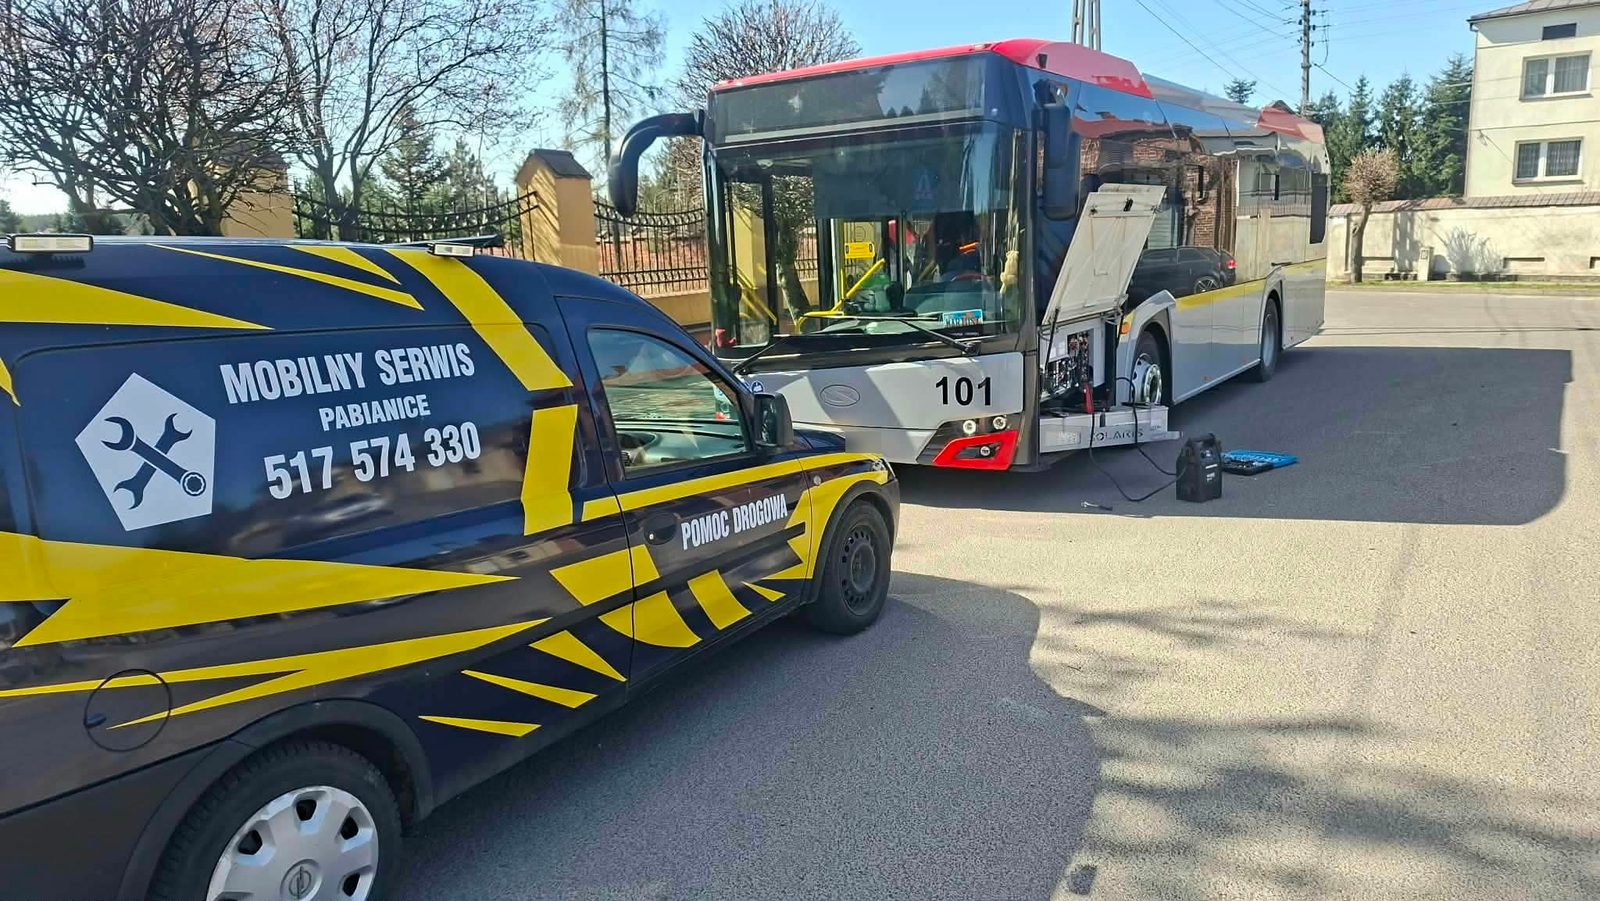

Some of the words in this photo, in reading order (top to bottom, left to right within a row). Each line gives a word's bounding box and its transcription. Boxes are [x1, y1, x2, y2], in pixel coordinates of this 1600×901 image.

[219, 353, 366, 404] MOBILNY
[375, 343, 475, 386] SERWIS
[935, 376, 992, 406] 101
[319, 394, 431, 431] PABIANICE
[1091, 429, 1144, 441] OLARIS
[264, 446, 333, 499] 517
[350, 433, 415, 482] 574
[424, 421, 481, 467] 330
[681, 510, 730, 550] POMOC
[732, 493, 788, 533] DROGOWA
